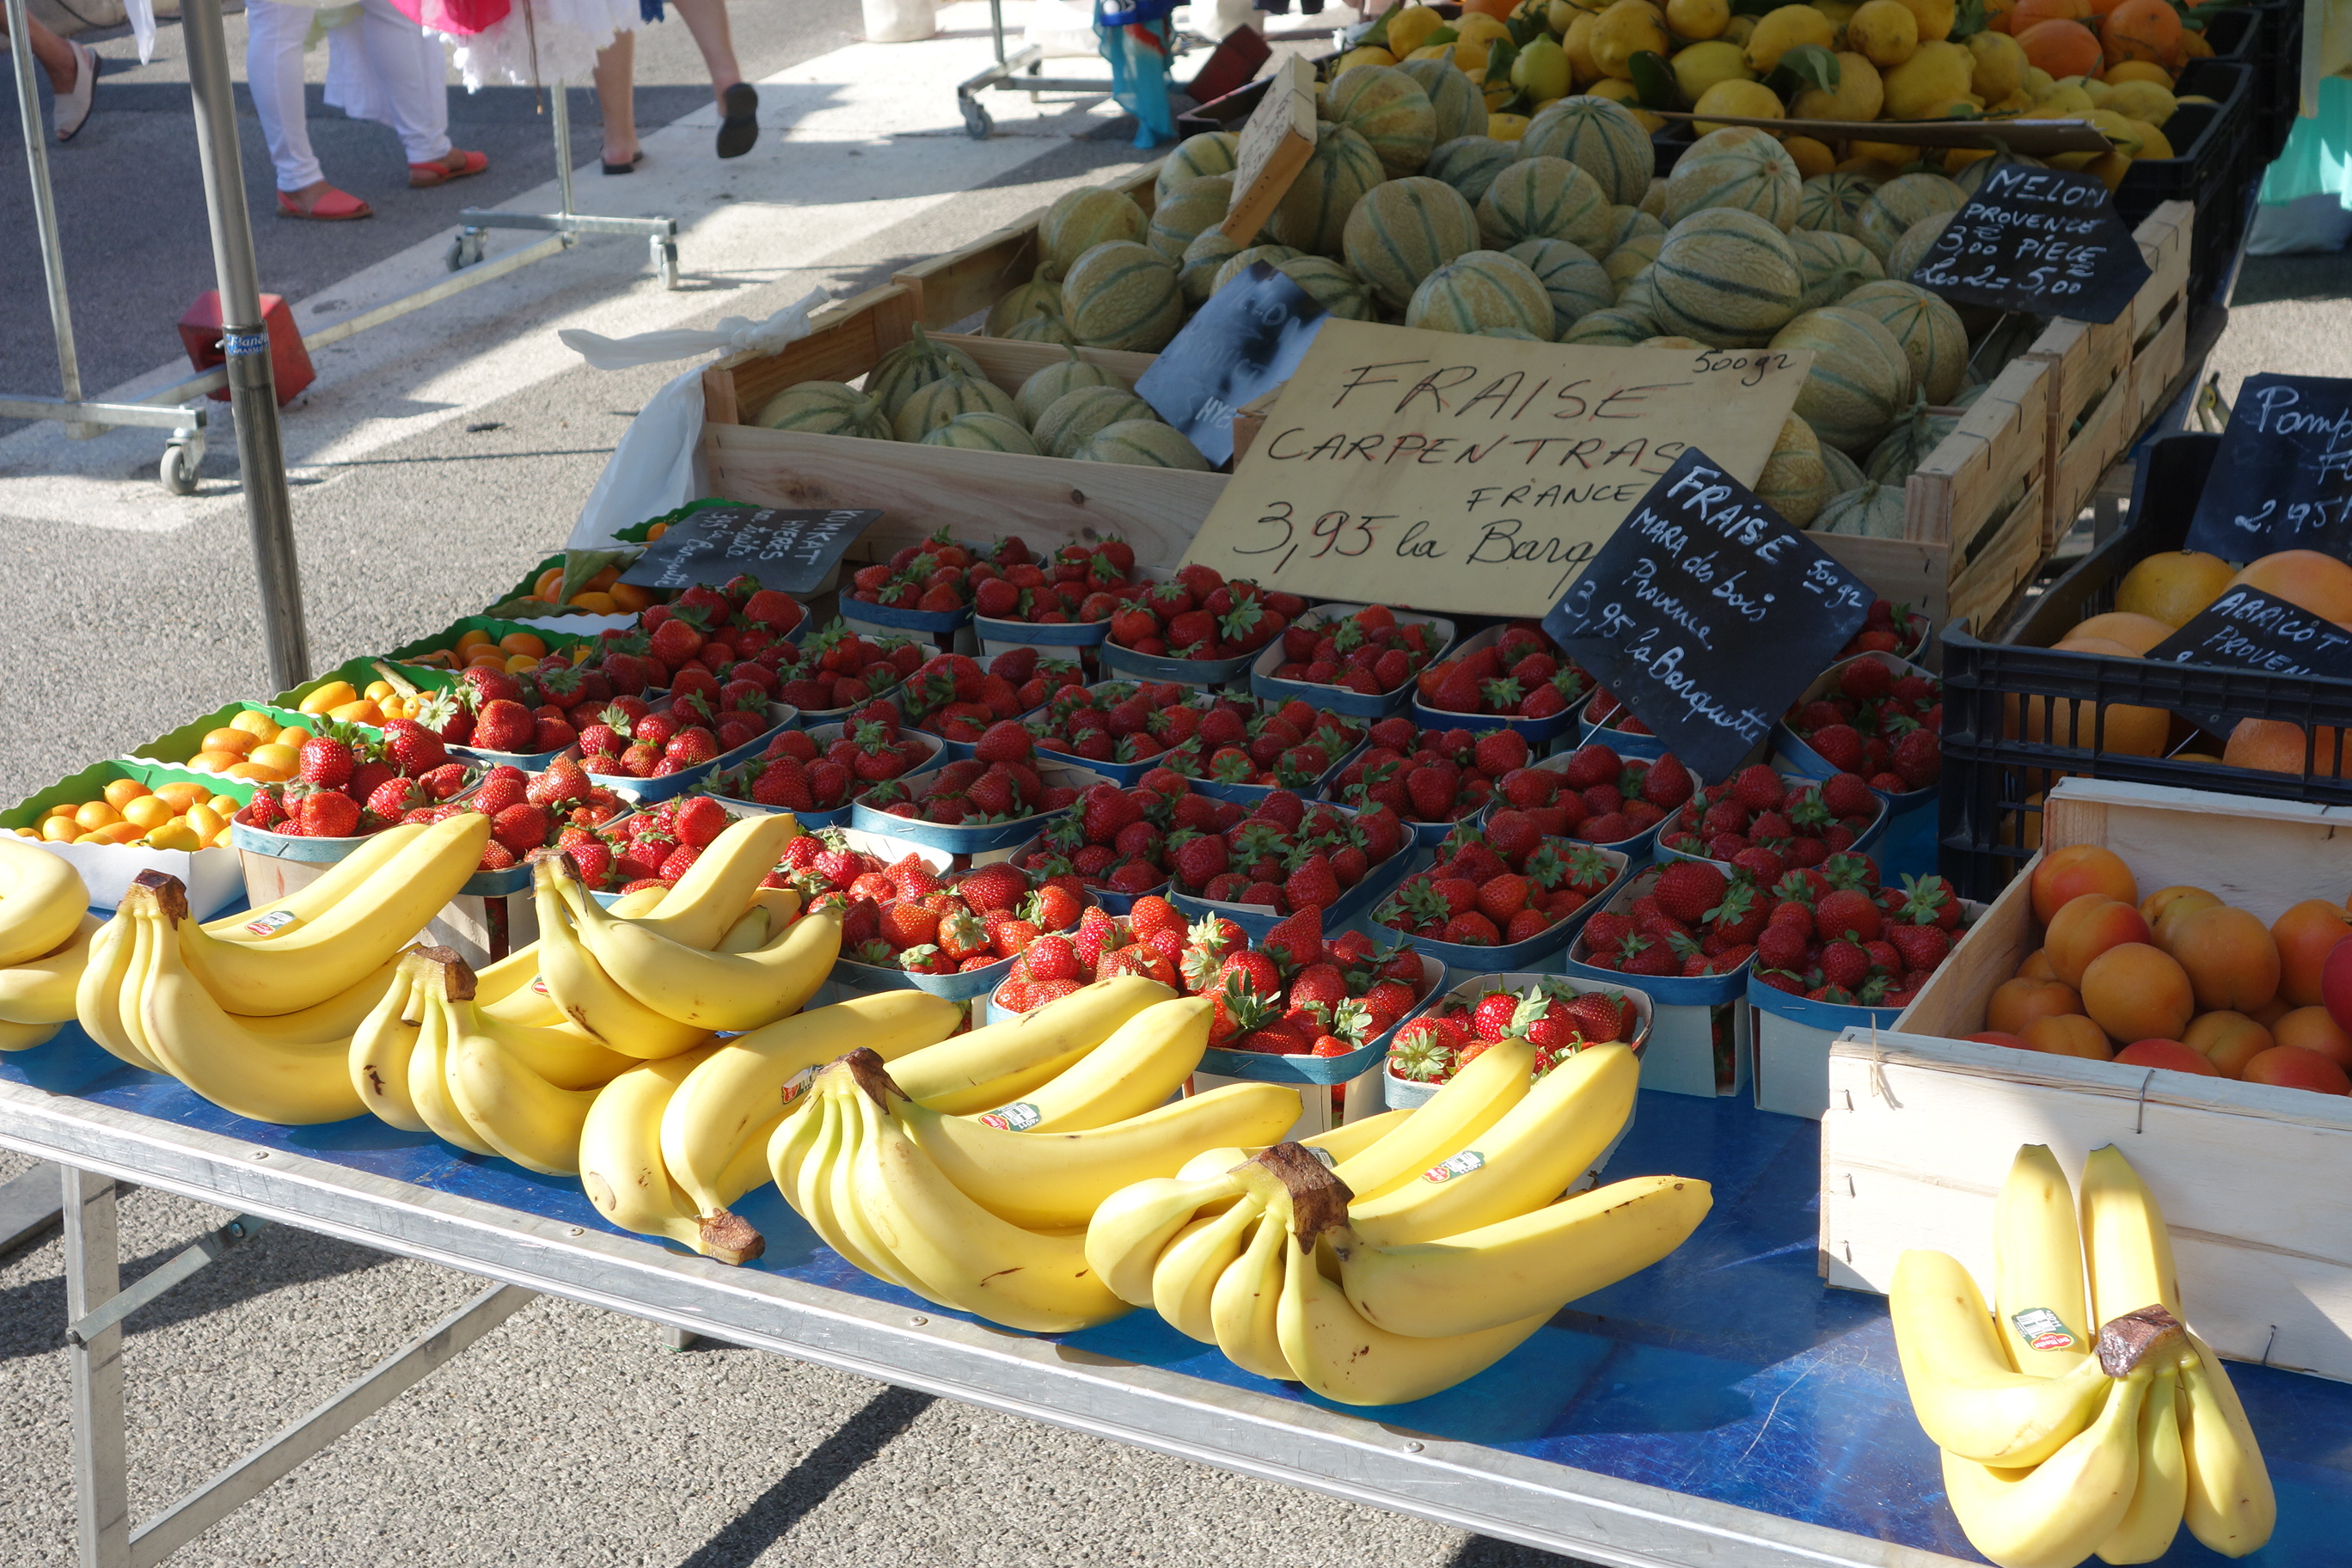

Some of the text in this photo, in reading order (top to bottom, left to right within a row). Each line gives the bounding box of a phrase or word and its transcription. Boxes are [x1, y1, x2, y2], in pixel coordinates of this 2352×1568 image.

[1987, 168, 2108, 208] MELON
[1332, 359, 1695, 421] FRAISE
[2257, 385, 2352, 453] Pamp
[1267, 427, 1684, 475] CARPENTRAS
[1467, 482, 1650, 513] FRANCE
[794, 510, 865, 565] KUMKAT
[1233, 501, 1596, 600] 3,95 la Barq
[1630, 507, 1776, 622] MARA des bois
[1624, 627, 1660, 663] la
